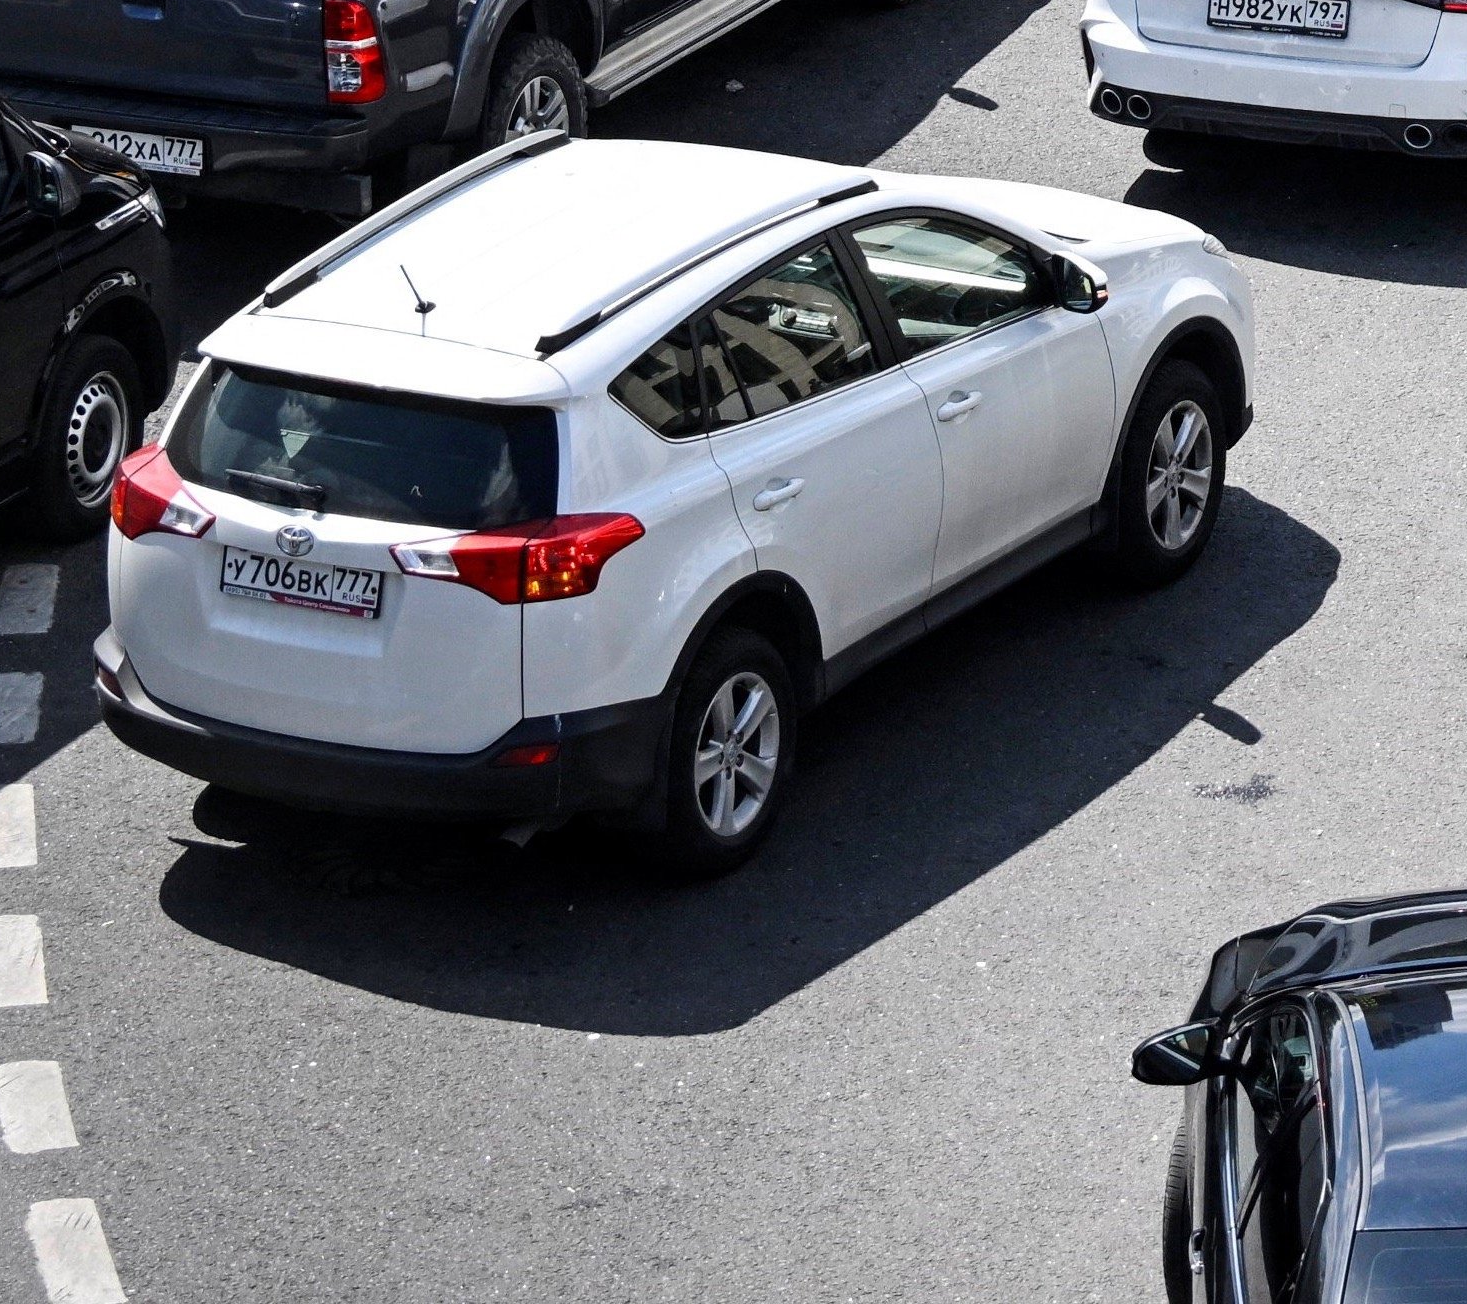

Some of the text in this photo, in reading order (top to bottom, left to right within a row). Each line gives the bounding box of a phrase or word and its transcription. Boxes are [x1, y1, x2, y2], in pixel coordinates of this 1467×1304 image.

[165, 137, 197, 159] 777
[234, 550, 371, 596] У706ВК 777
